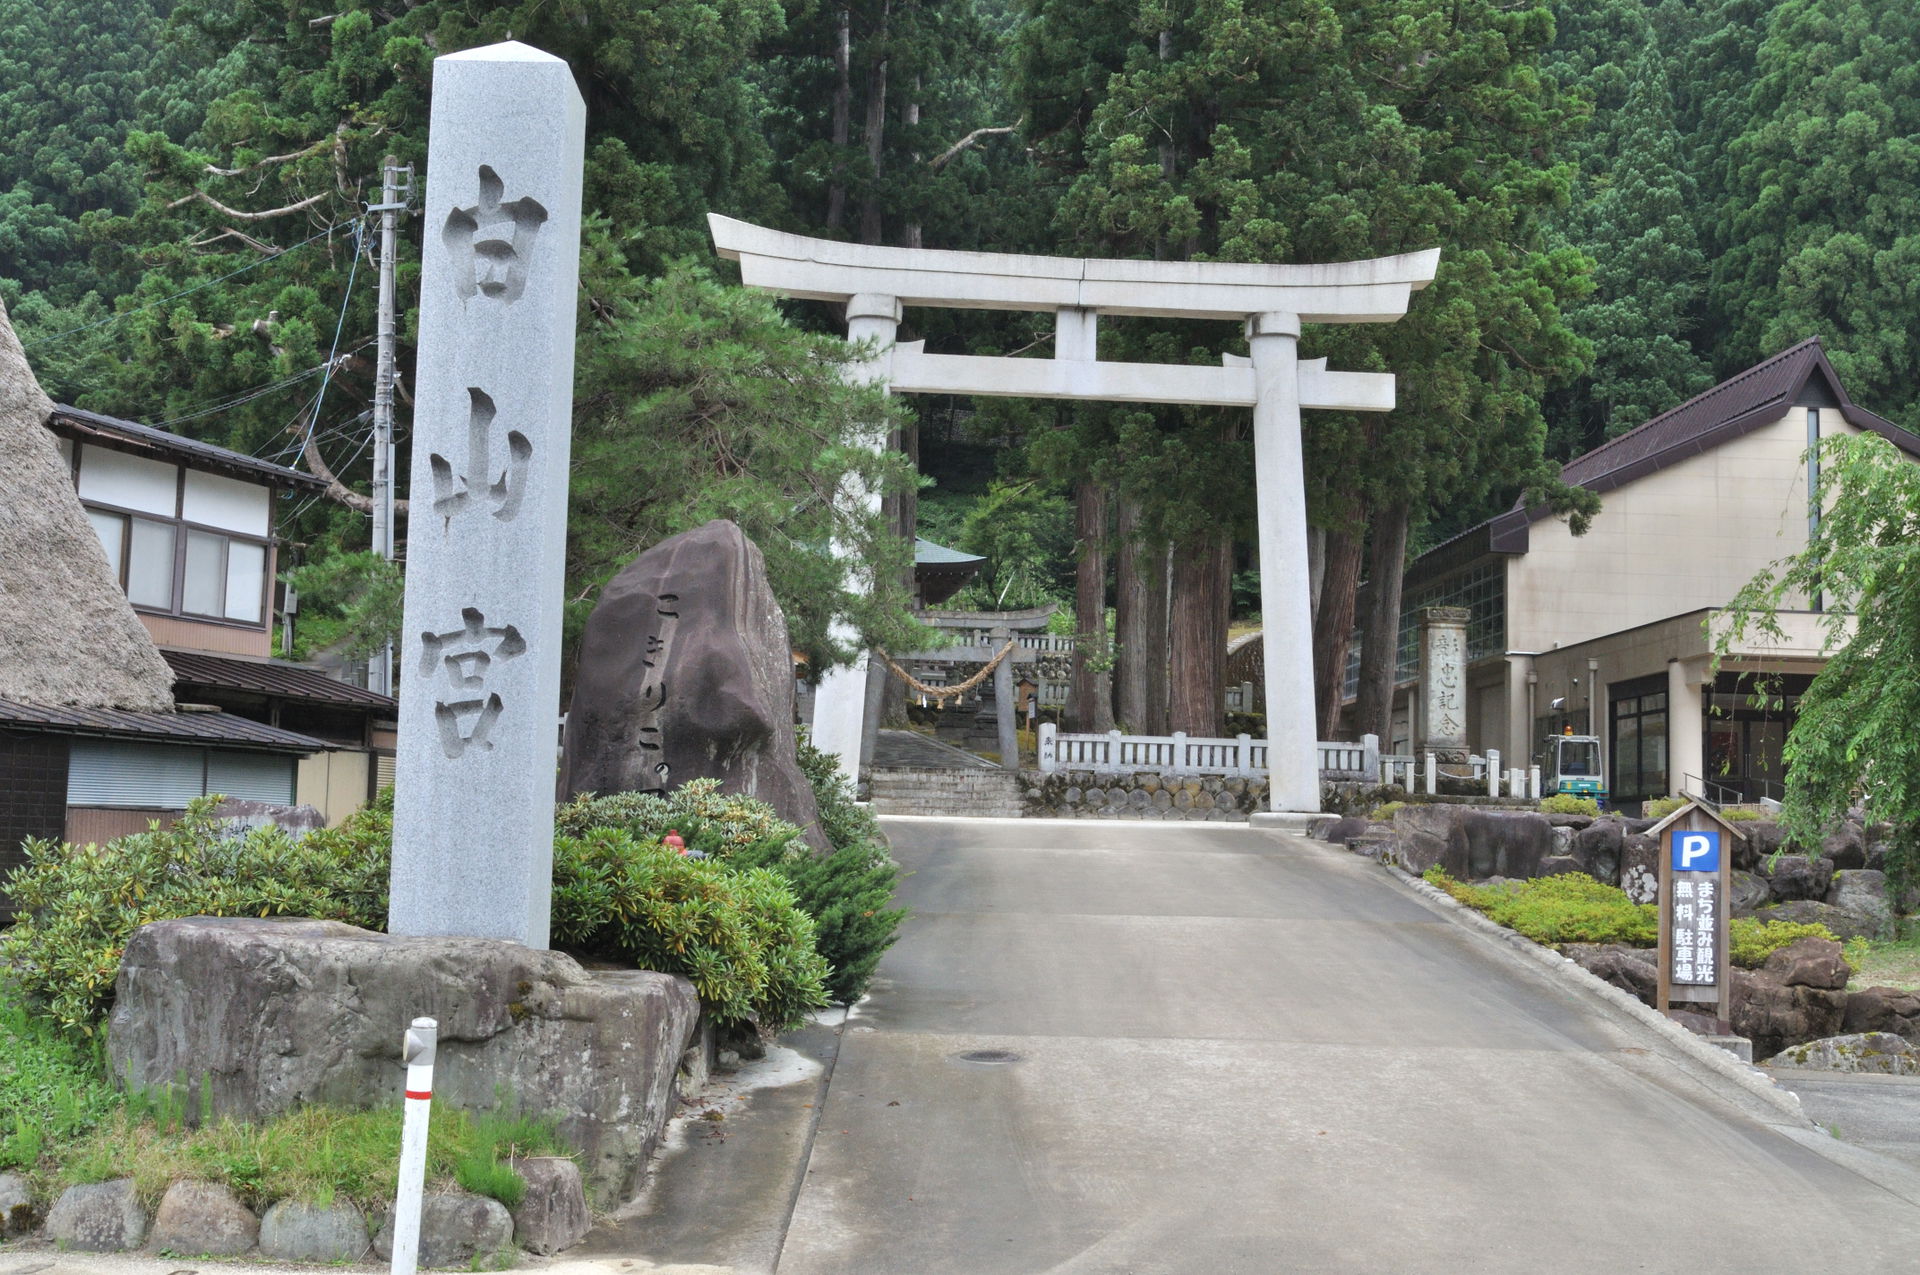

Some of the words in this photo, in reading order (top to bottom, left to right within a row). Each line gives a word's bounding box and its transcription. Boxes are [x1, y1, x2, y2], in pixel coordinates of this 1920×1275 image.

[1681, 835, 1711, 867] P
[1696, 881, 1714, 982] まち並み観光
